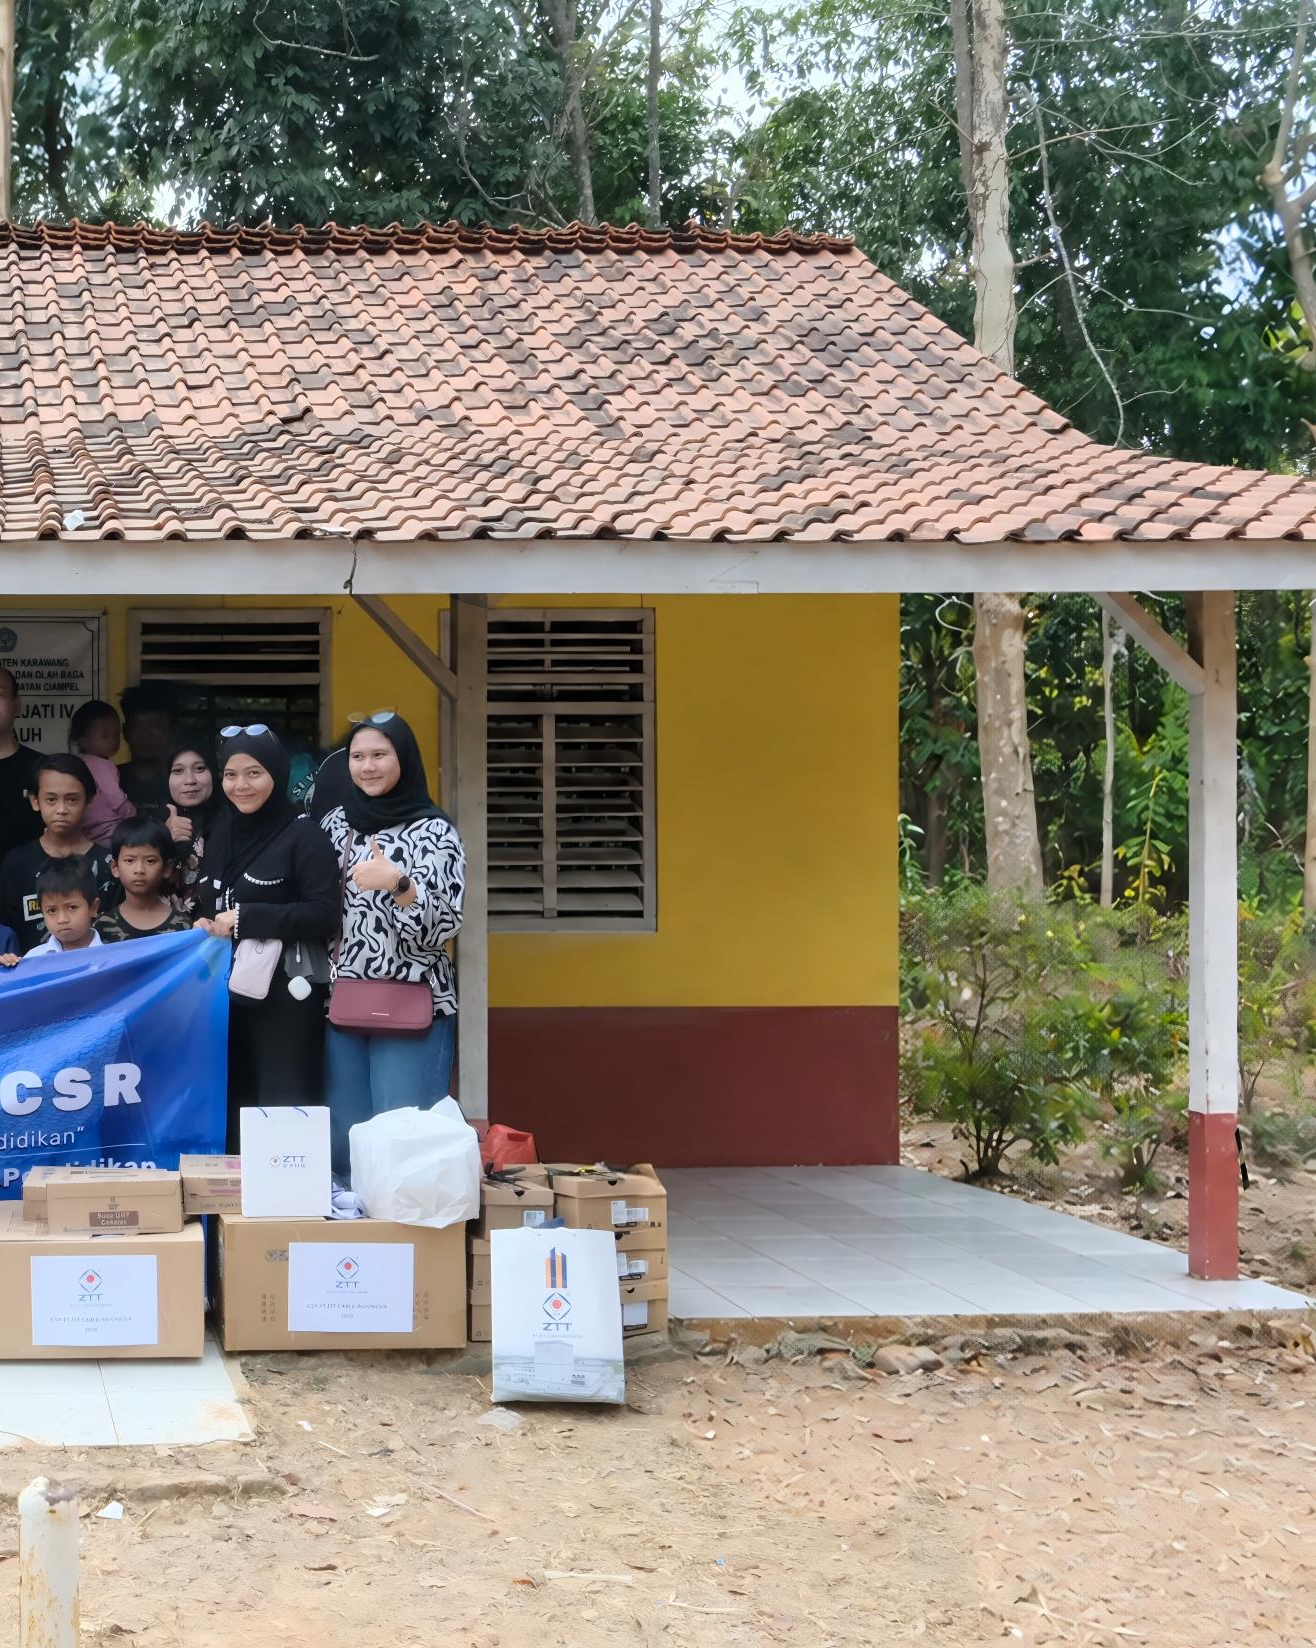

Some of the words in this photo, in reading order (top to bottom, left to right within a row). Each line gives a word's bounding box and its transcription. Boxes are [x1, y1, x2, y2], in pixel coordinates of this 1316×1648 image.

[21, 658, 69, 667] KARAWANG
[16, 671, 30, 679] DAN
[35, 671, 58, 679] OLAH
[61, 671, 84, 679] RAGA
[44, 683, 80, 691] CIAMPEL
[60, 704, 75, 719] IV
[0, 1062, 142, 1116] CSR
[283, 1155, 306, 1163] ZTT
[335, 1281, 361, 1289] ZTT
[78, 1293, 104, 1302] ZTT
[542, 1322, 572, 1331] ZTT
